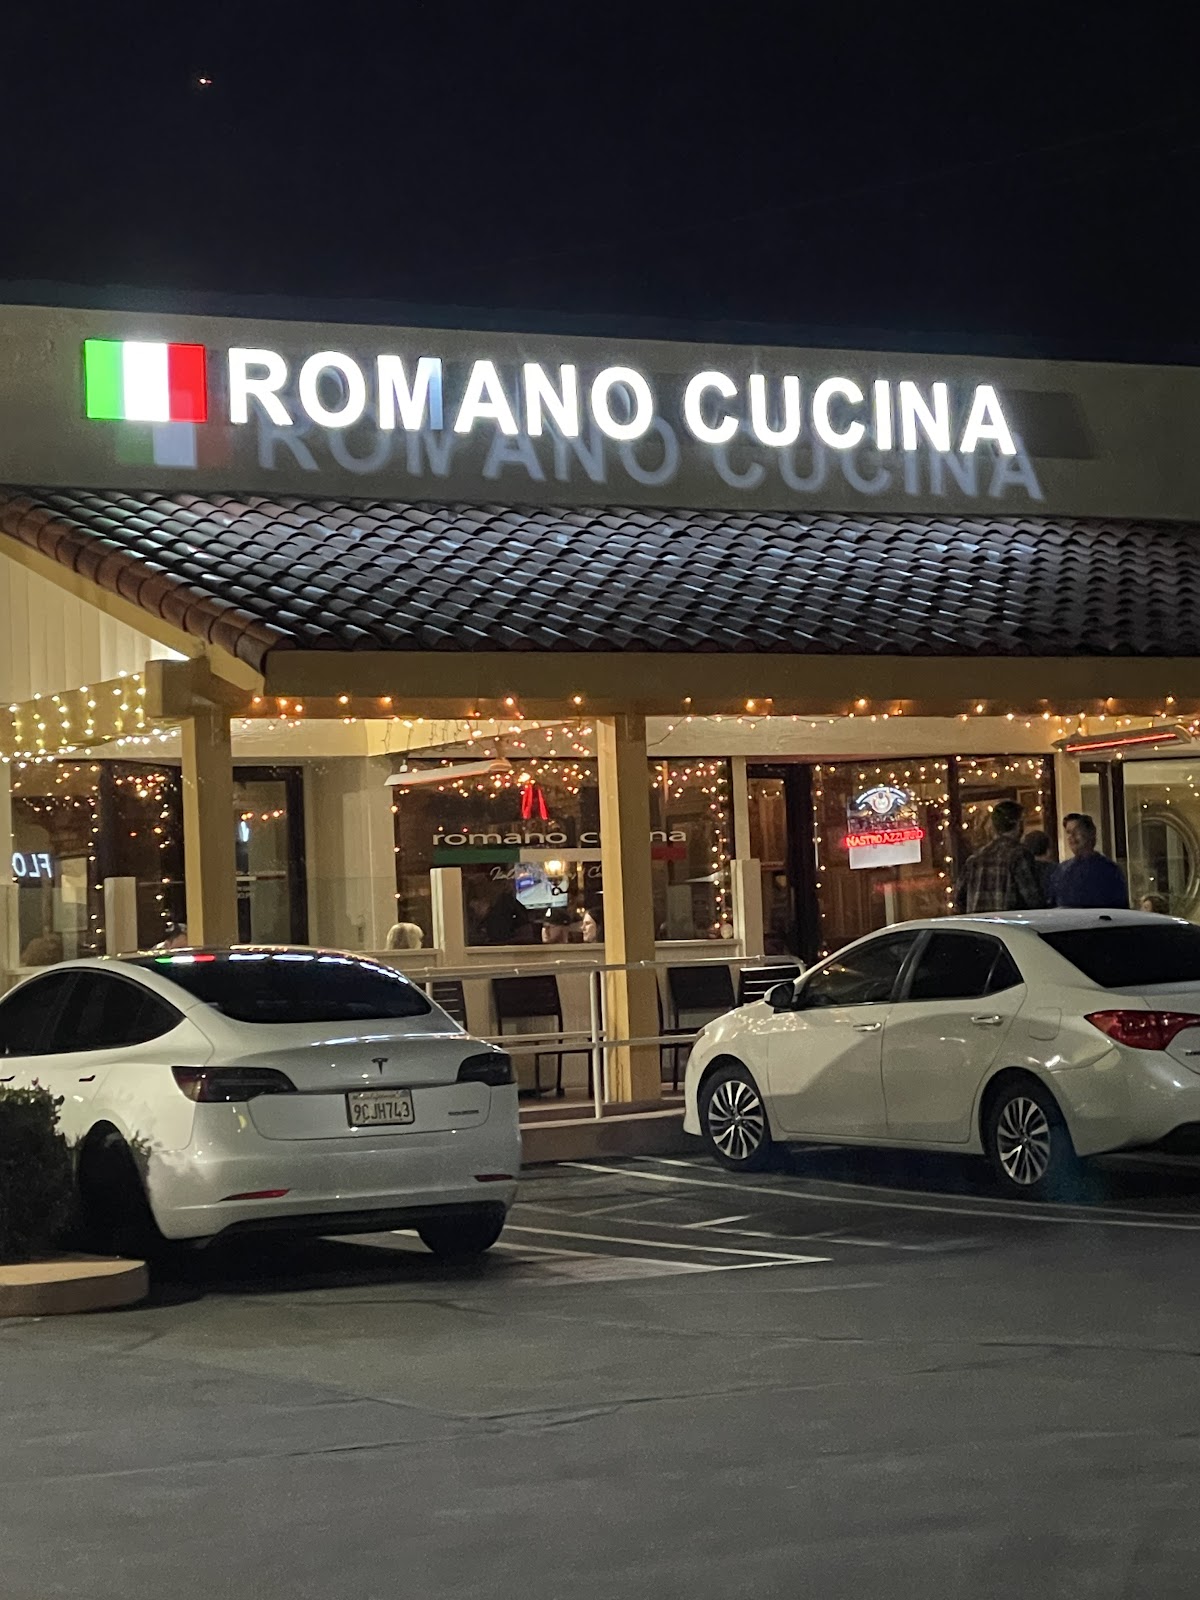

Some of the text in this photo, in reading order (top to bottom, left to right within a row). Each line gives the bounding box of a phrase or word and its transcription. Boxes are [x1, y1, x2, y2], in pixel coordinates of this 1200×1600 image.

[228, 347, 1017, 456] ROMANO CUCINA
[432, 830, 686, 846] romano cna
[354, 1101, 410, 1121] 9CJH743
